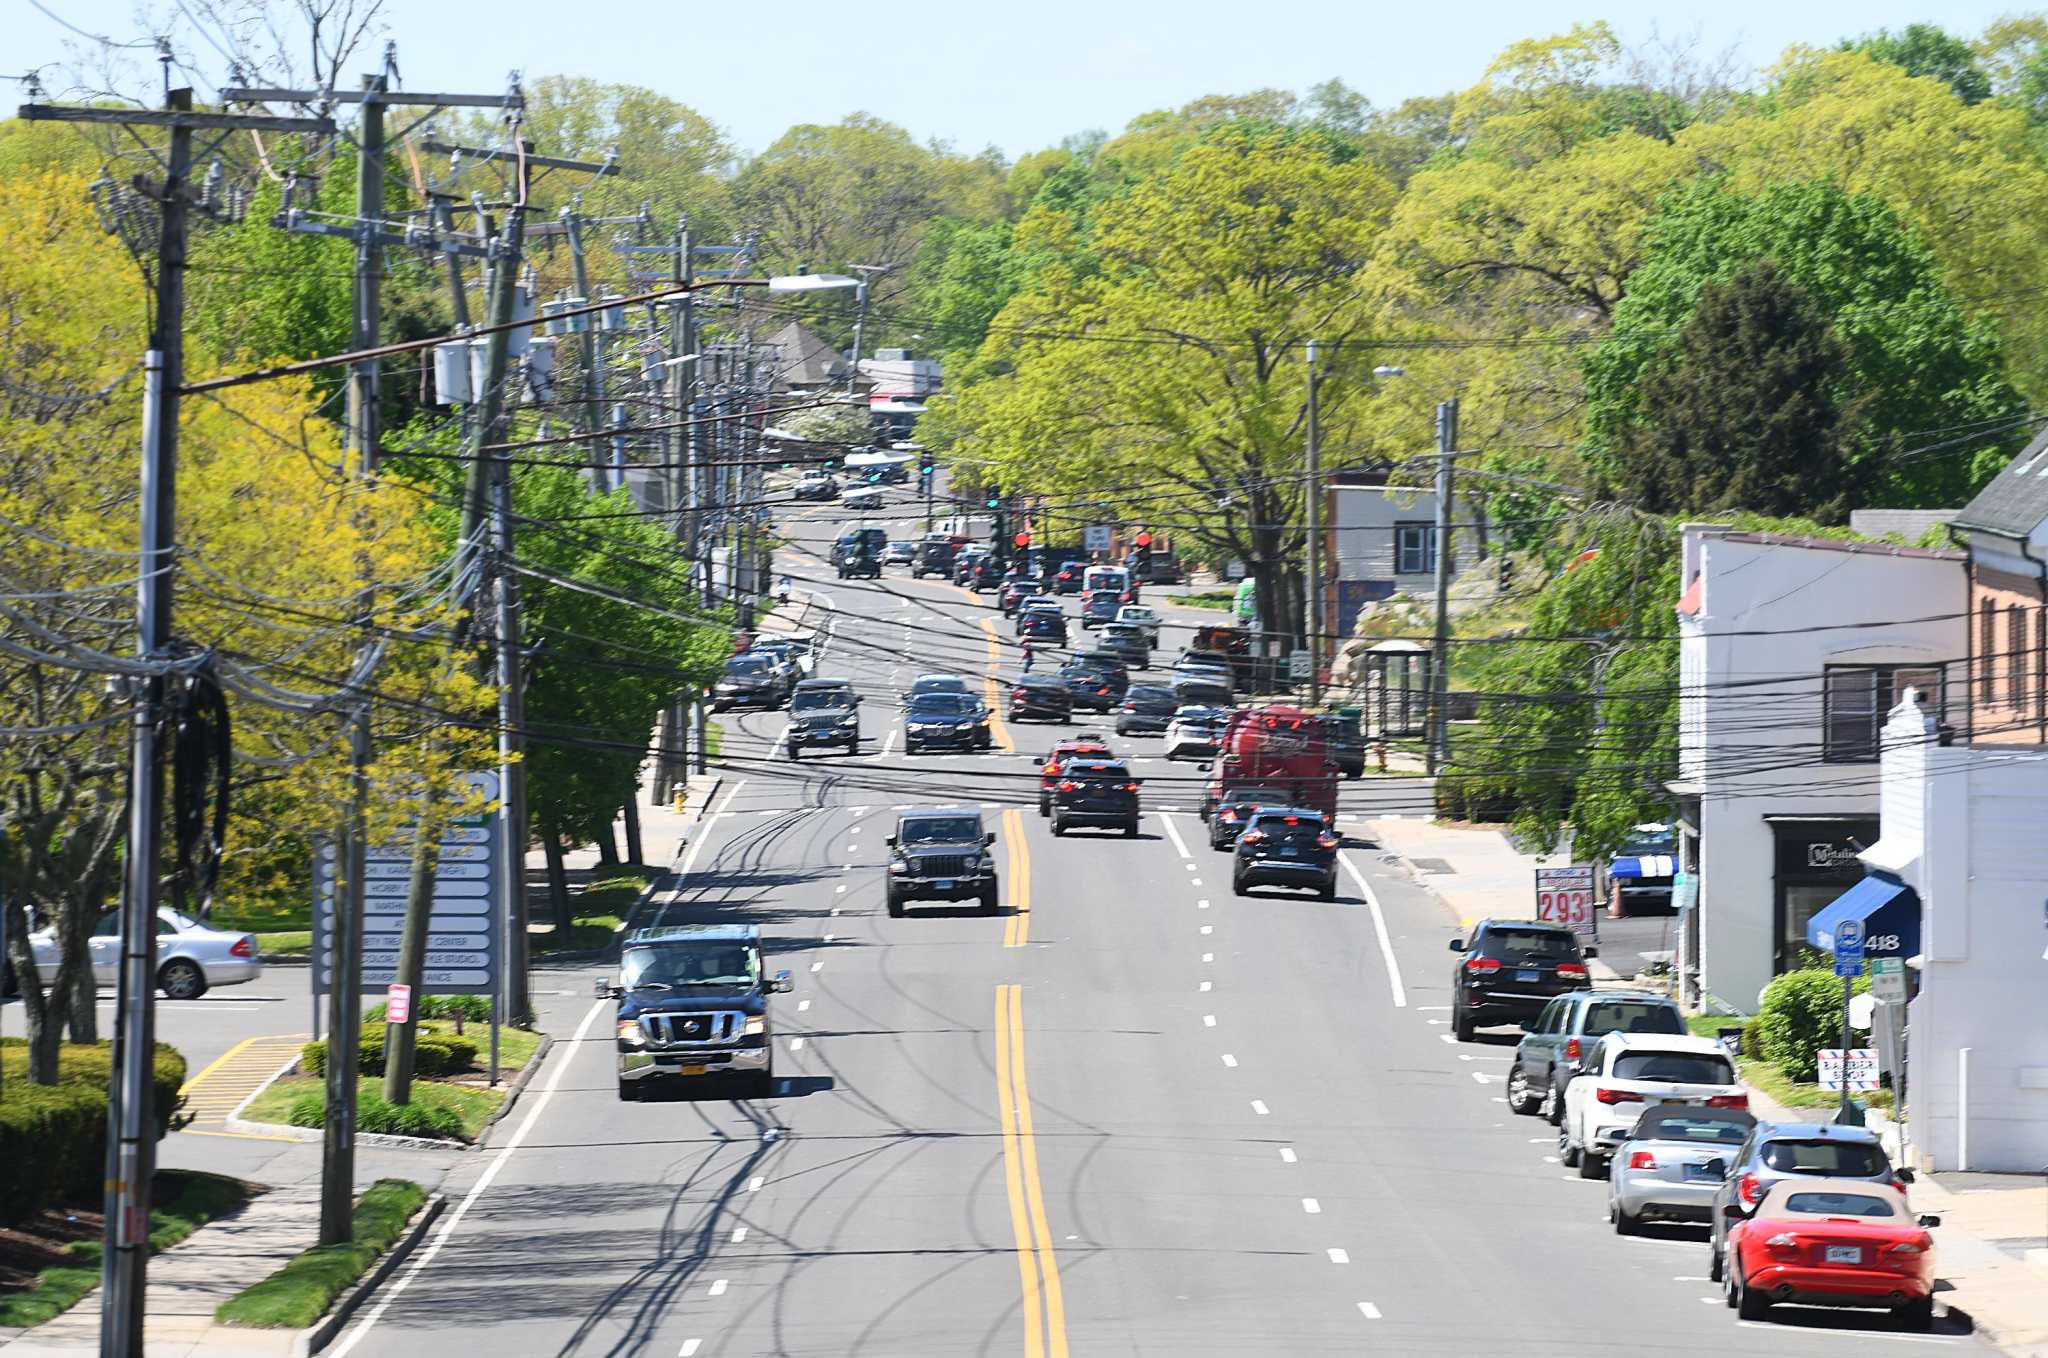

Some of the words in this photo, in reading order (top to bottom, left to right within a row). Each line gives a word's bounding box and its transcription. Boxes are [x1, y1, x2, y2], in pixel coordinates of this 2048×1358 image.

[1864, 934, 1901, 951] 418
[1823, 1060, 1875, 1070] BABER
[1832, 1071, 1866, 1080] SOP
